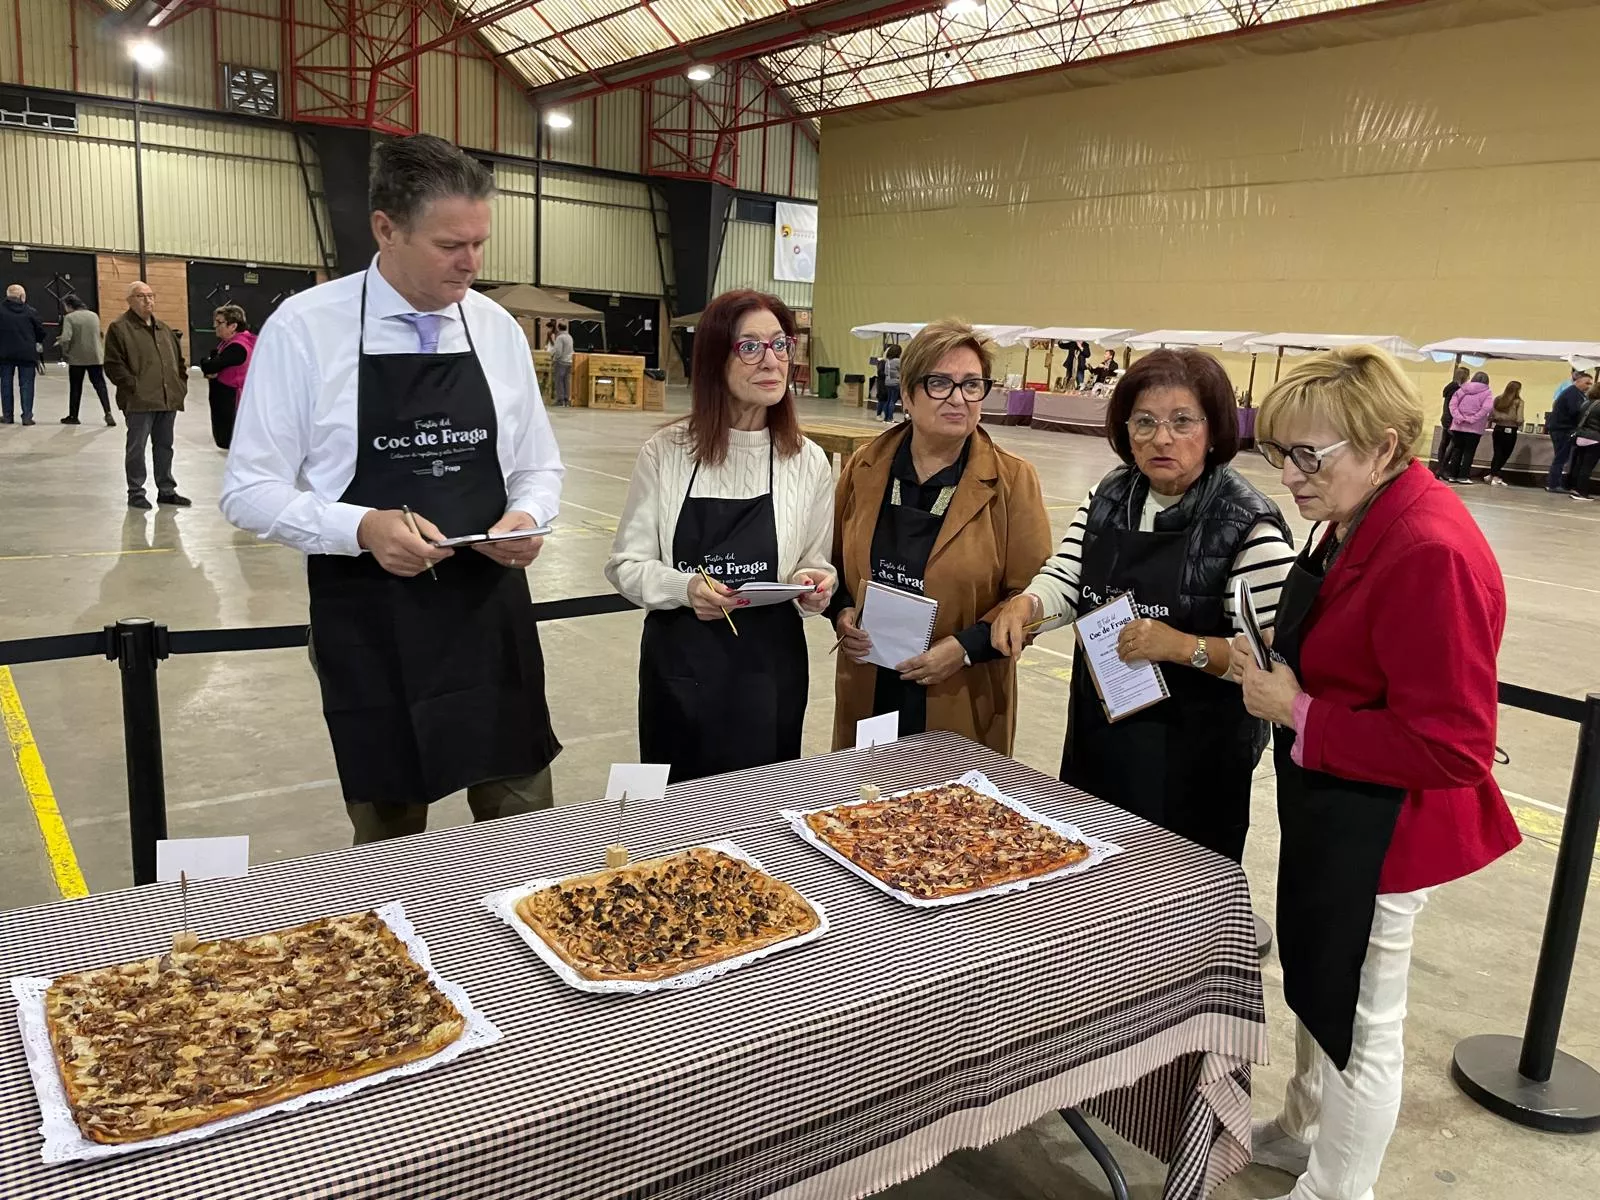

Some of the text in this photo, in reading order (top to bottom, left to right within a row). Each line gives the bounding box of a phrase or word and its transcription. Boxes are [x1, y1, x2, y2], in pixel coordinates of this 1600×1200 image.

[373, 428, 488, 451] Coc de Fraga
[705, 564, 724, 575] de
[726, 561, 768, 575] Fraga
[878, 569, 895, 581] de
[1089, 631, 1102, 640] Coc
[1102, 626, 1110, 634] de
[1110, 616, 1132, 630] Fraga
